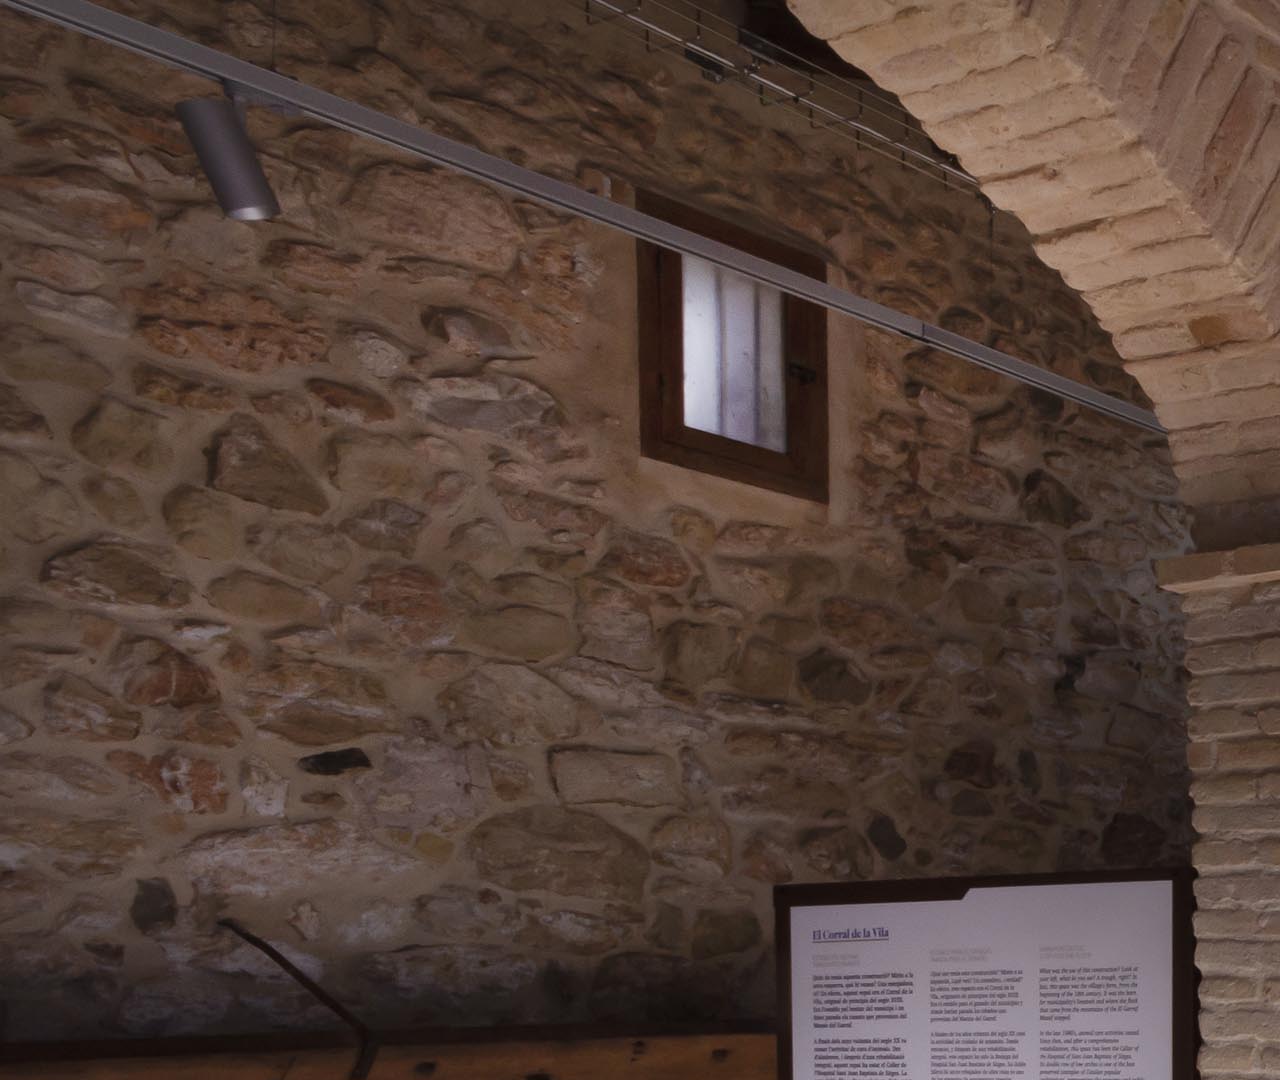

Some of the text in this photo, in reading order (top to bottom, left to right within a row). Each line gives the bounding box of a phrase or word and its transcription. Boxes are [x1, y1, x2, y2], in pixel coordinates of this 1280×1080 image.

[813, 927, 889, 940] El Corral de la Vila
